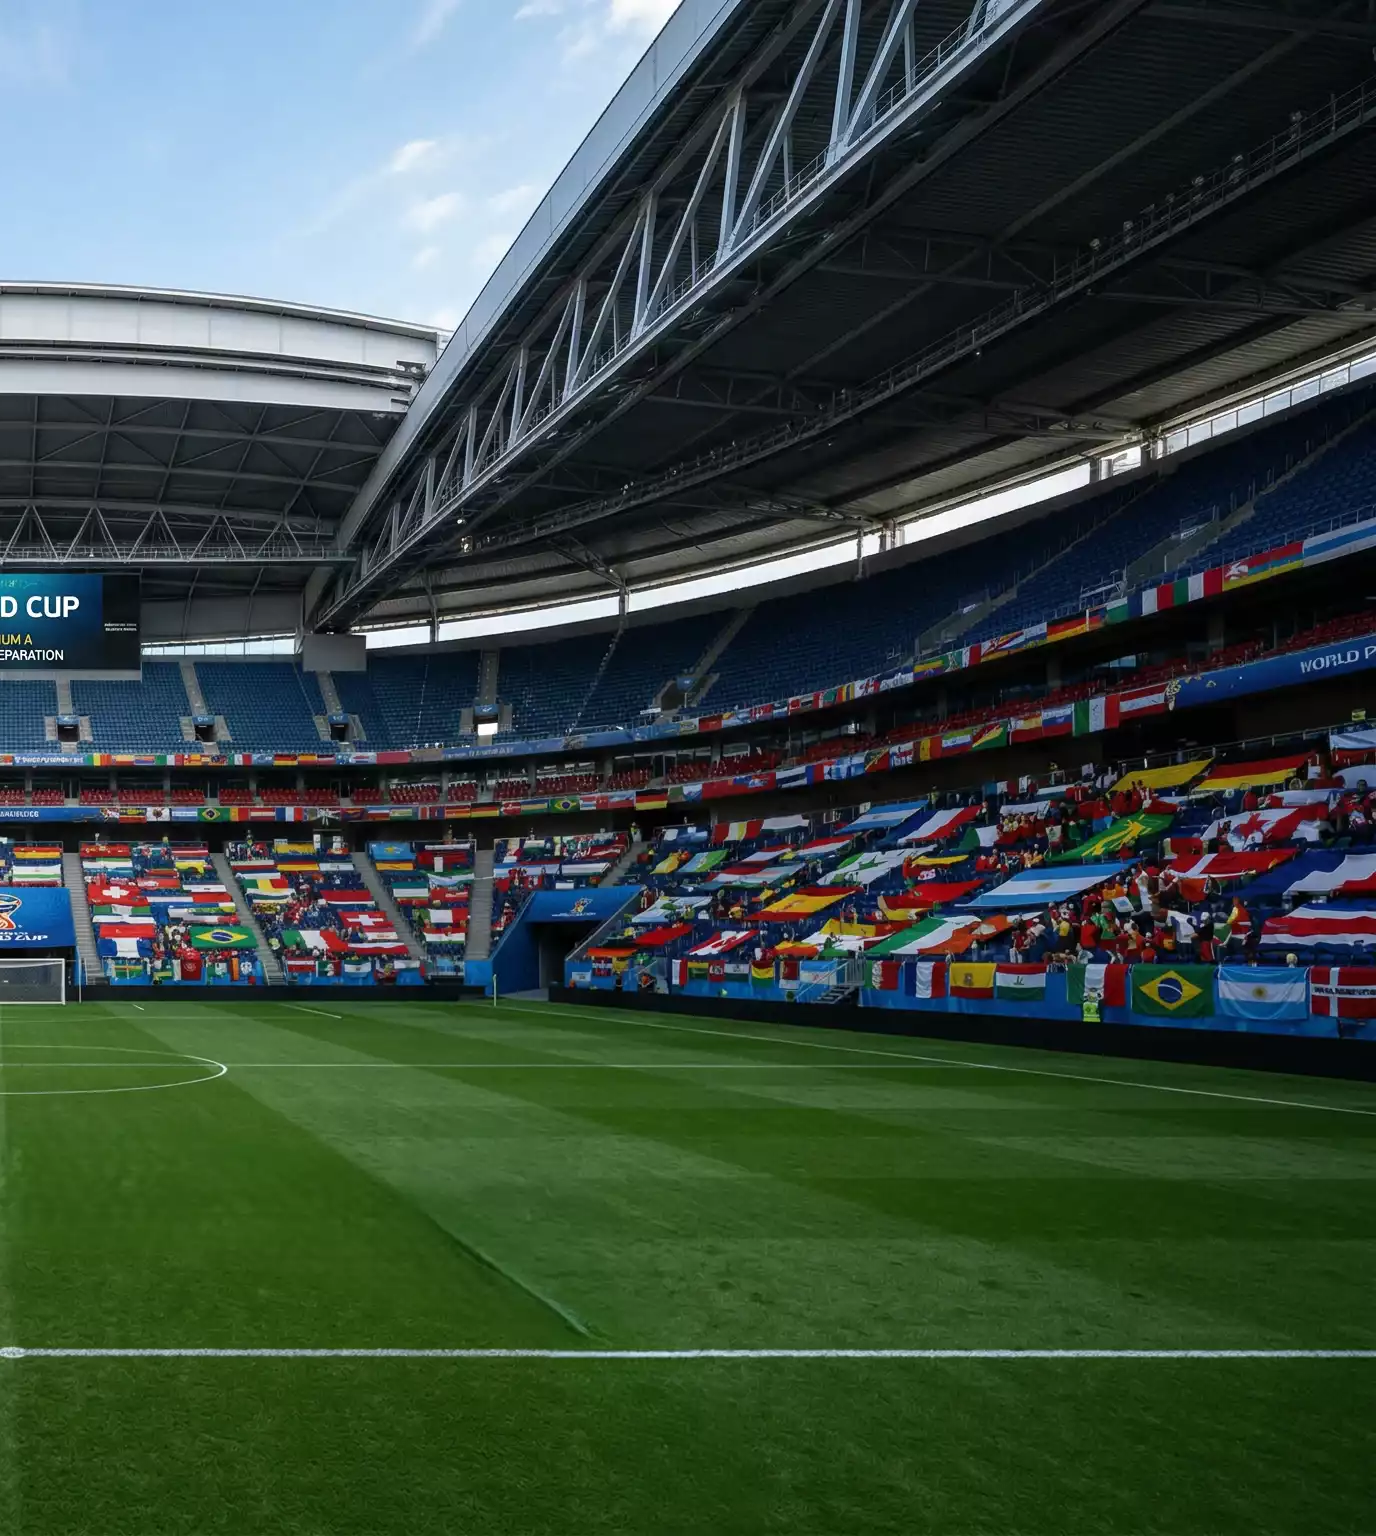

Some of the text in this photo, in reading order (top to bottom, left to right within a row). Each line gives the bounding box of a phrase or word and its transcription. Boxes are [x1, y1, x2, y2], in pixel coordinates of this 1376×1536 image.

[26, 595, 80, 618] CUP
[24, 633, 33, 646] A
[1300, 650, 1360, 673] WORLD
